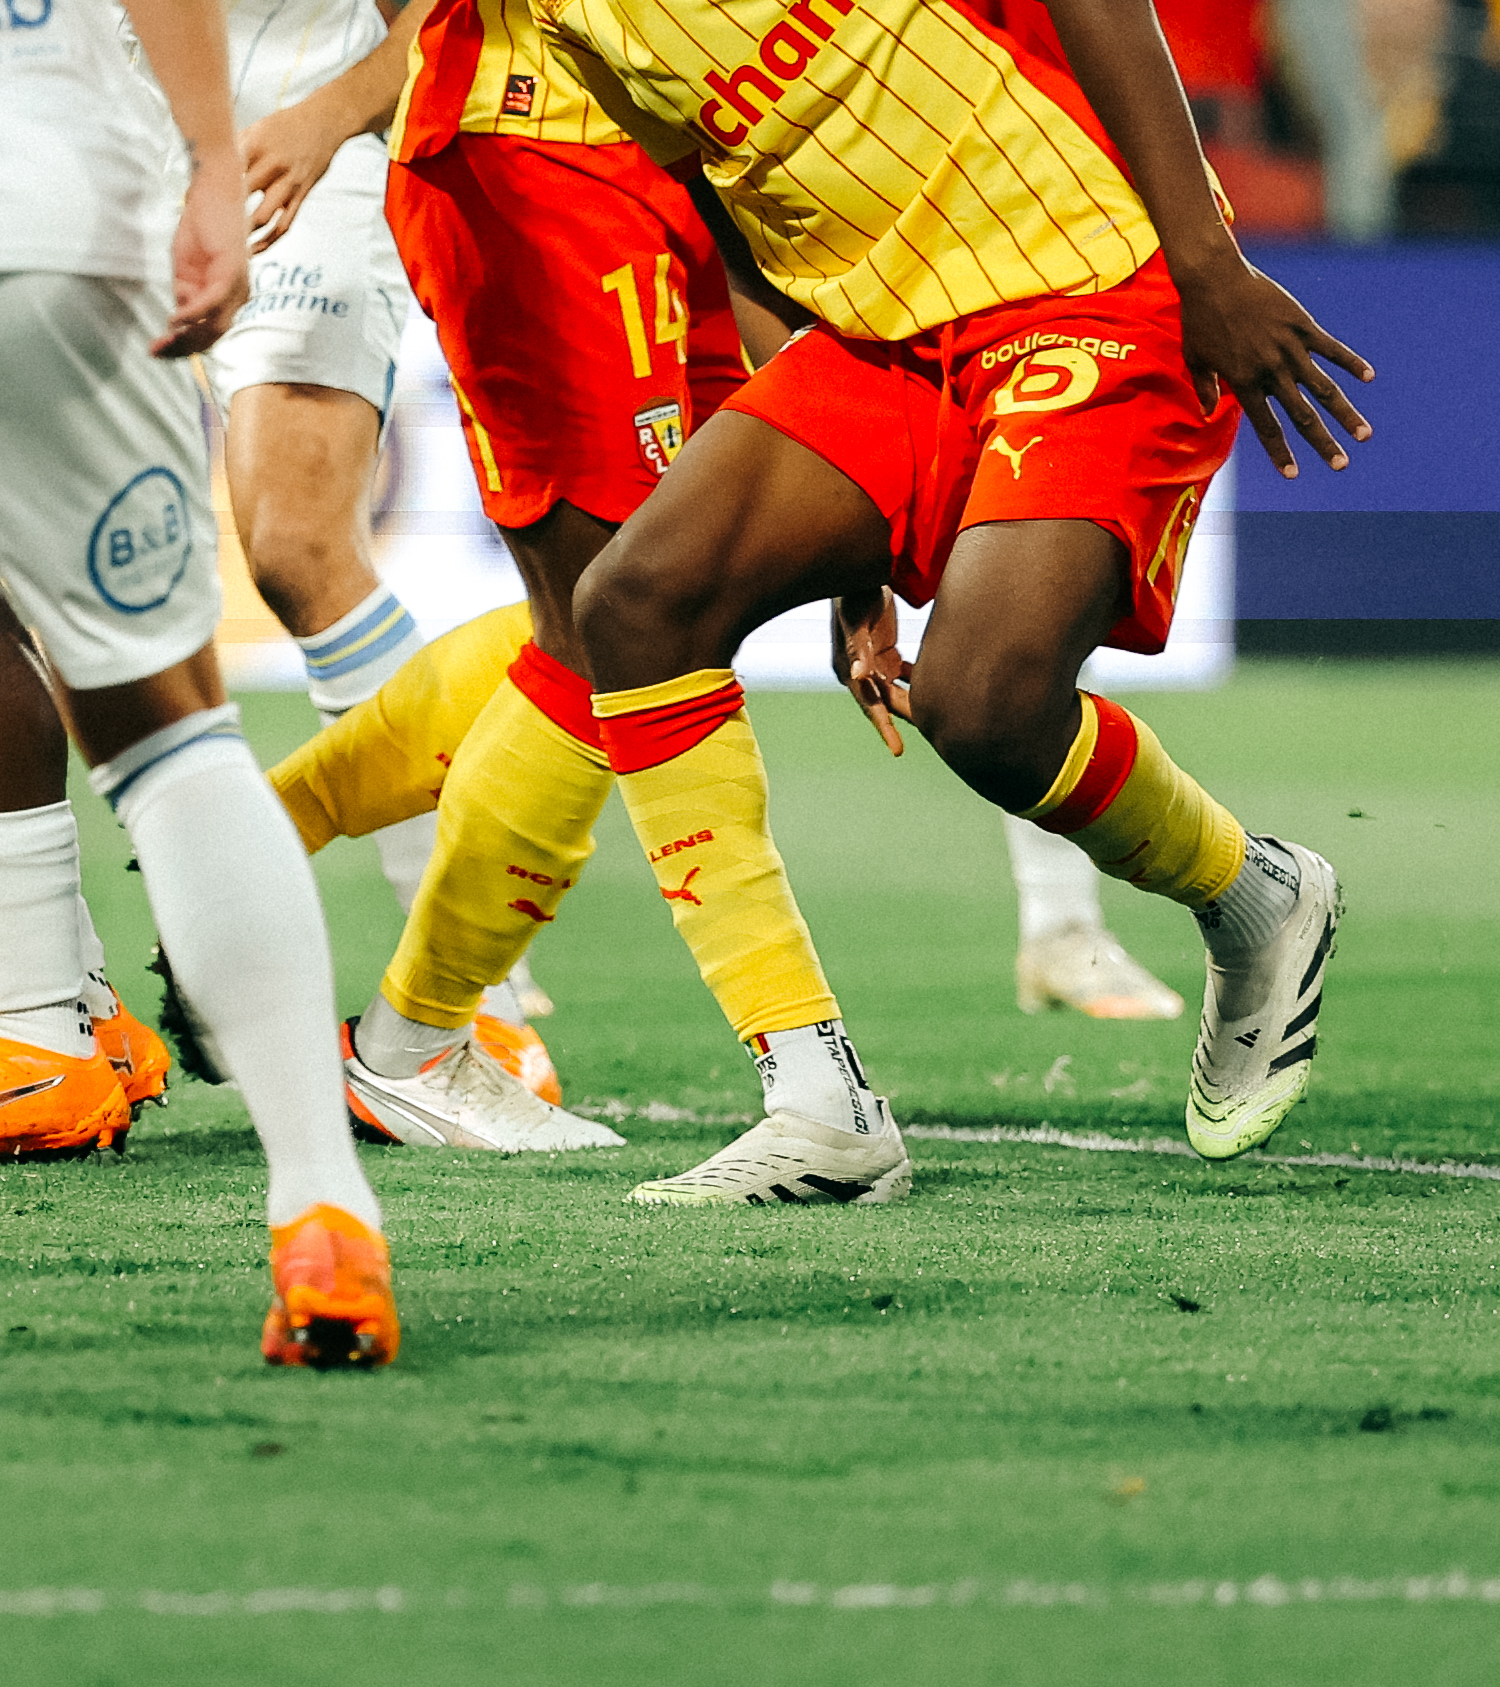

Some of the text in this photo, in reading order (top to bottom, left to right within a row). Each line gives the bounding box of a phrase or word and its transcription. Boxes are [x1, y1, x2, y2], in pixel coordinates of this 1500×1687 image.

[600, 252, 688, 379] 14
[980, 331, 1138, 370] boulanger
[638, 426, 669, 475] RCL
[649, 828, 714, 863] LENS
